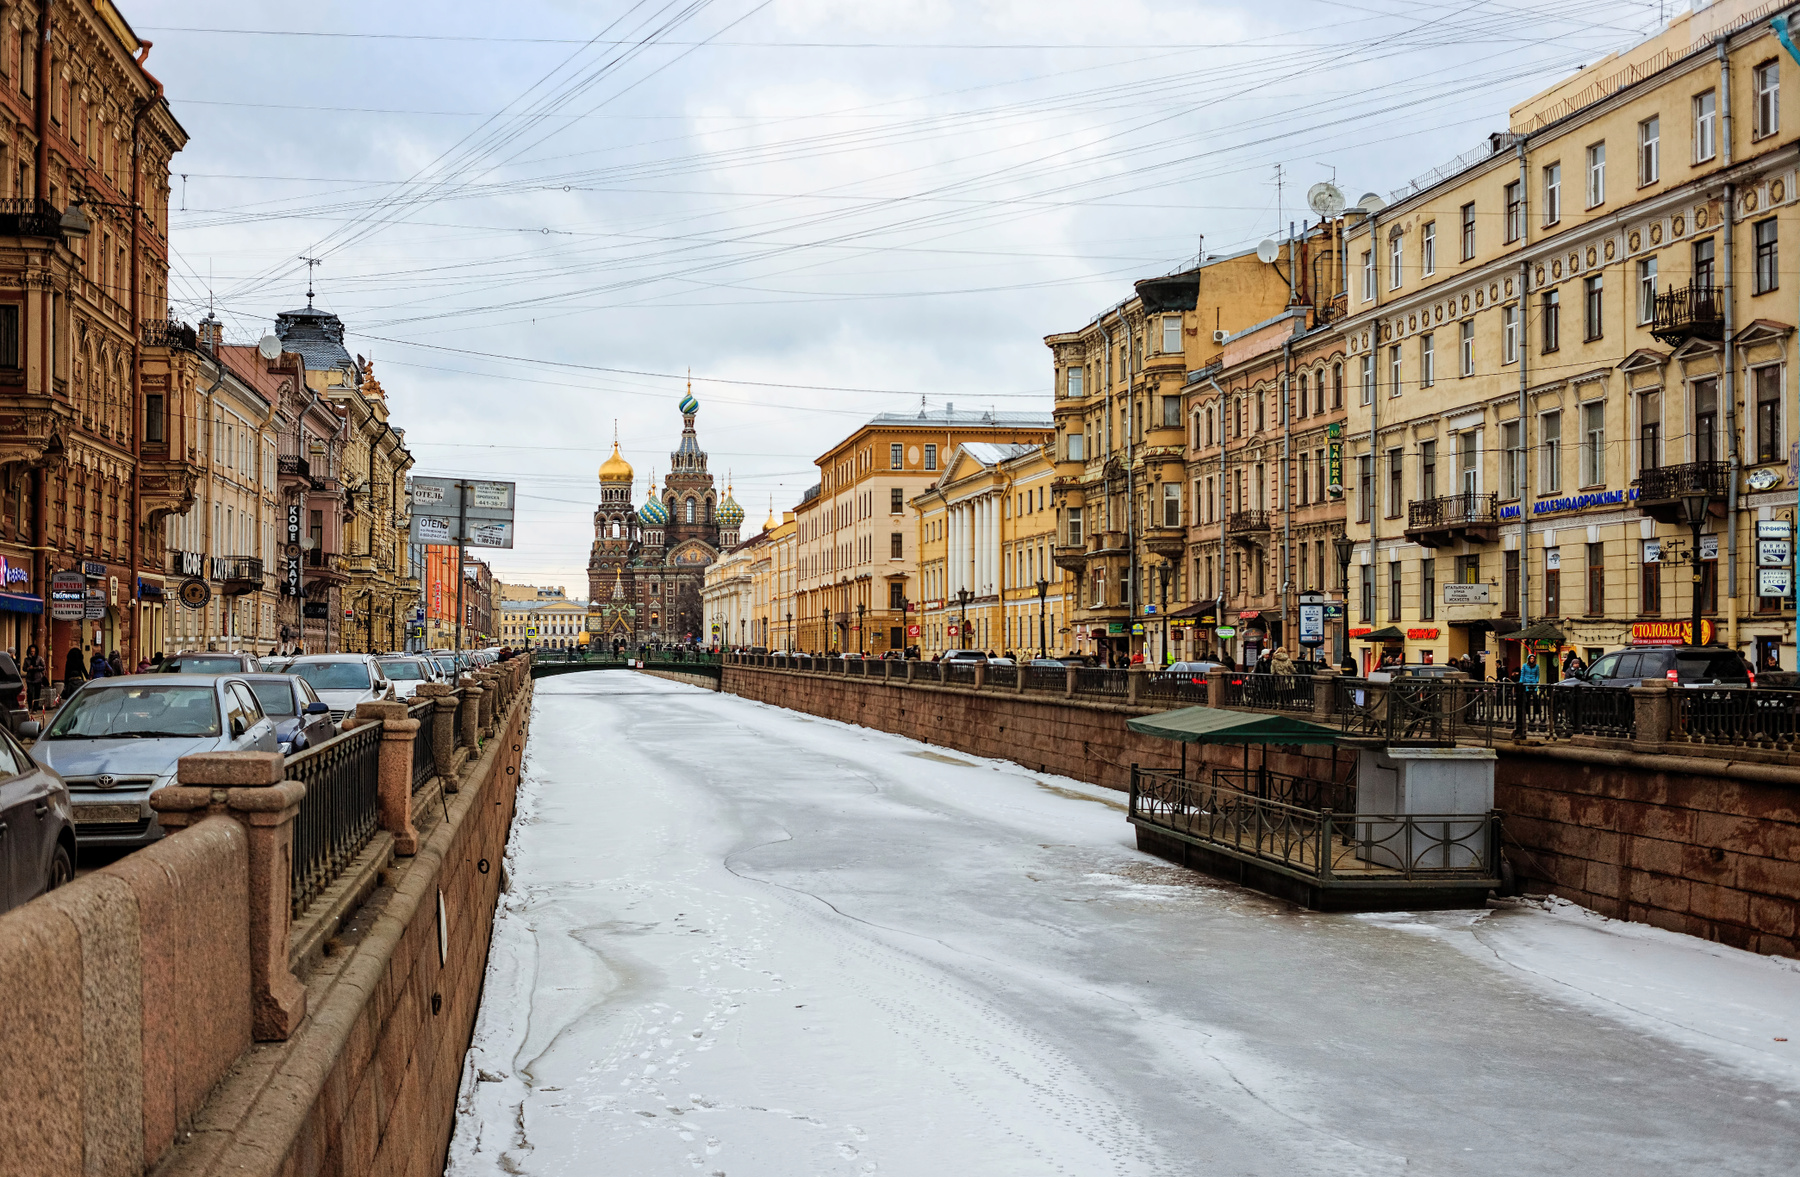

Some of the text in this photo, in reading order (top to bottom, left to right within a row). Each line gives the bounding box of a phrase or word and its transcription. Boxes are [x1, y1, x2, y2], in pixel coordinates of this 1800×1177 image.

[415, 490, 443, 500] ОТЕЛЬ
[1500, 505, 1520, 518] АВИА
[1533, 489, 1624, 514] ЖЕЛЕЗНОДОРОЖНЫЕ
[288, 506, 298, 541] КОФЕ
[182, 551, 227, 580] КОФЕ ХАУЗ
[288, 560, 298, 595] ХАУЗ
[1632, 623, 1680, 638] СТОЛОВАЯ
